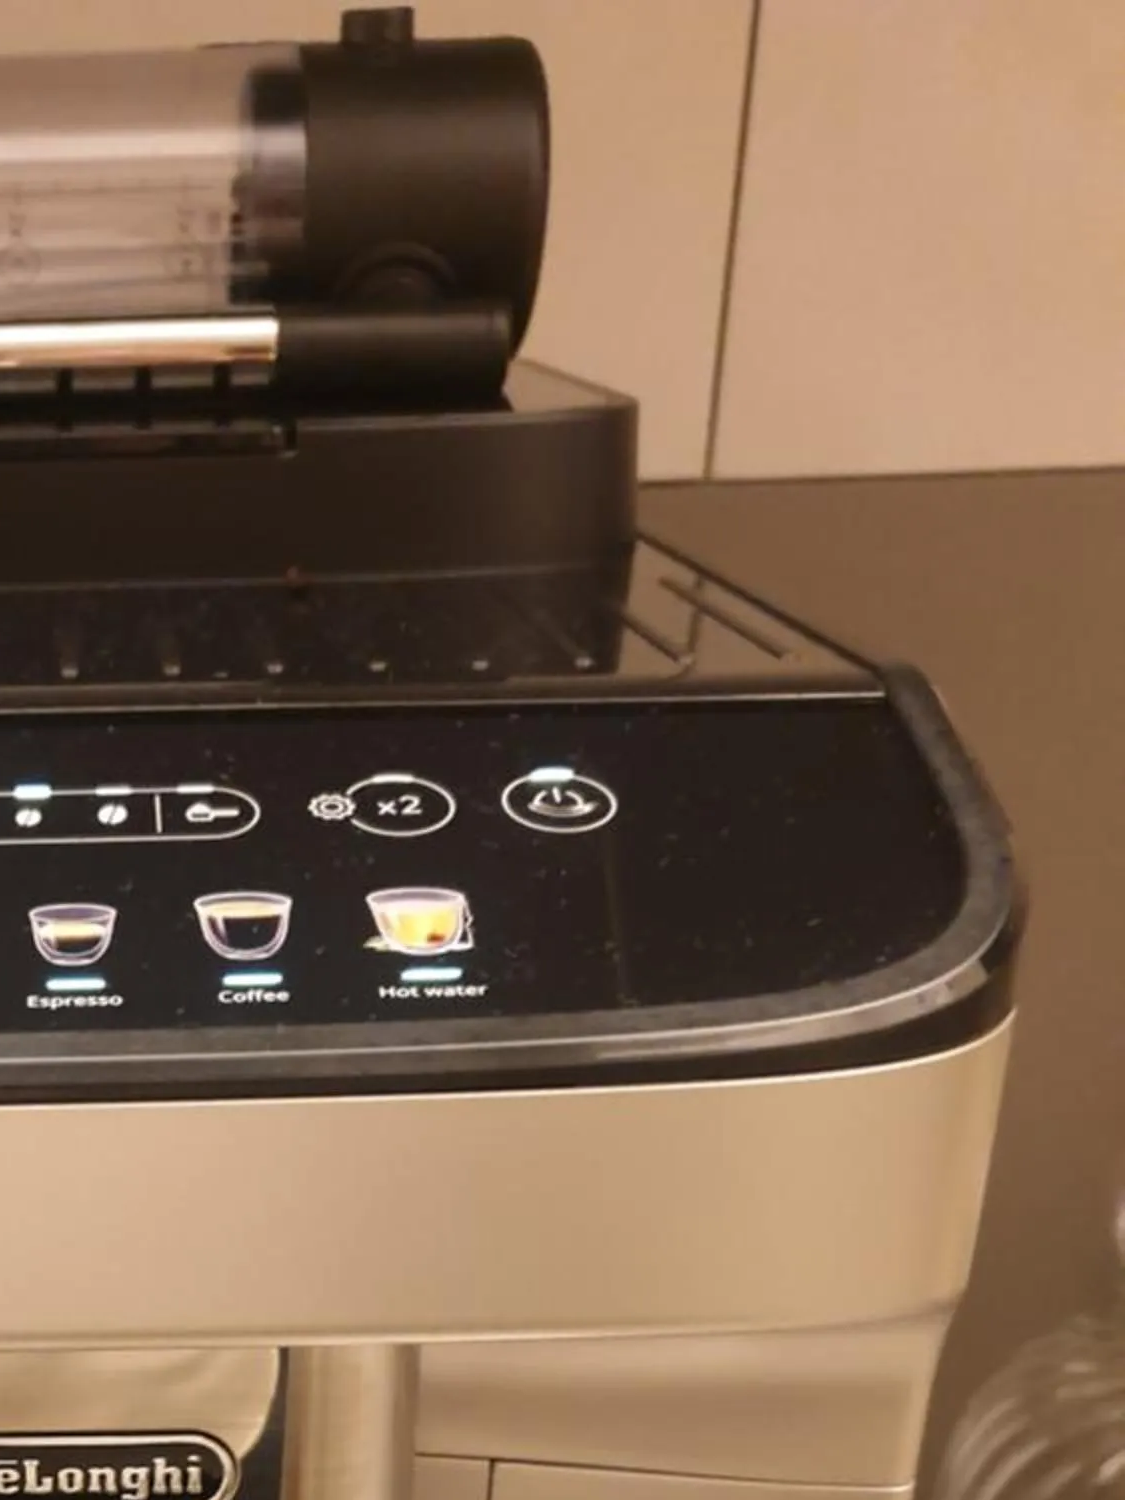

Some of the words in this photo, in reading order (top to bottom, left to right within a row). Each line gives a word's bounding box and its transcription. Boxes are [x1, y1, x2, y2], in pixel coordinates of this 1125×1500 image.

[376, 794, 422, 816] x2
[217, 988, 291, 1004] Coffee
[378, 984, 419, 999] Hot
[423, 983, 488, 998] water
[26, 993, 124, 1011] Espresso
